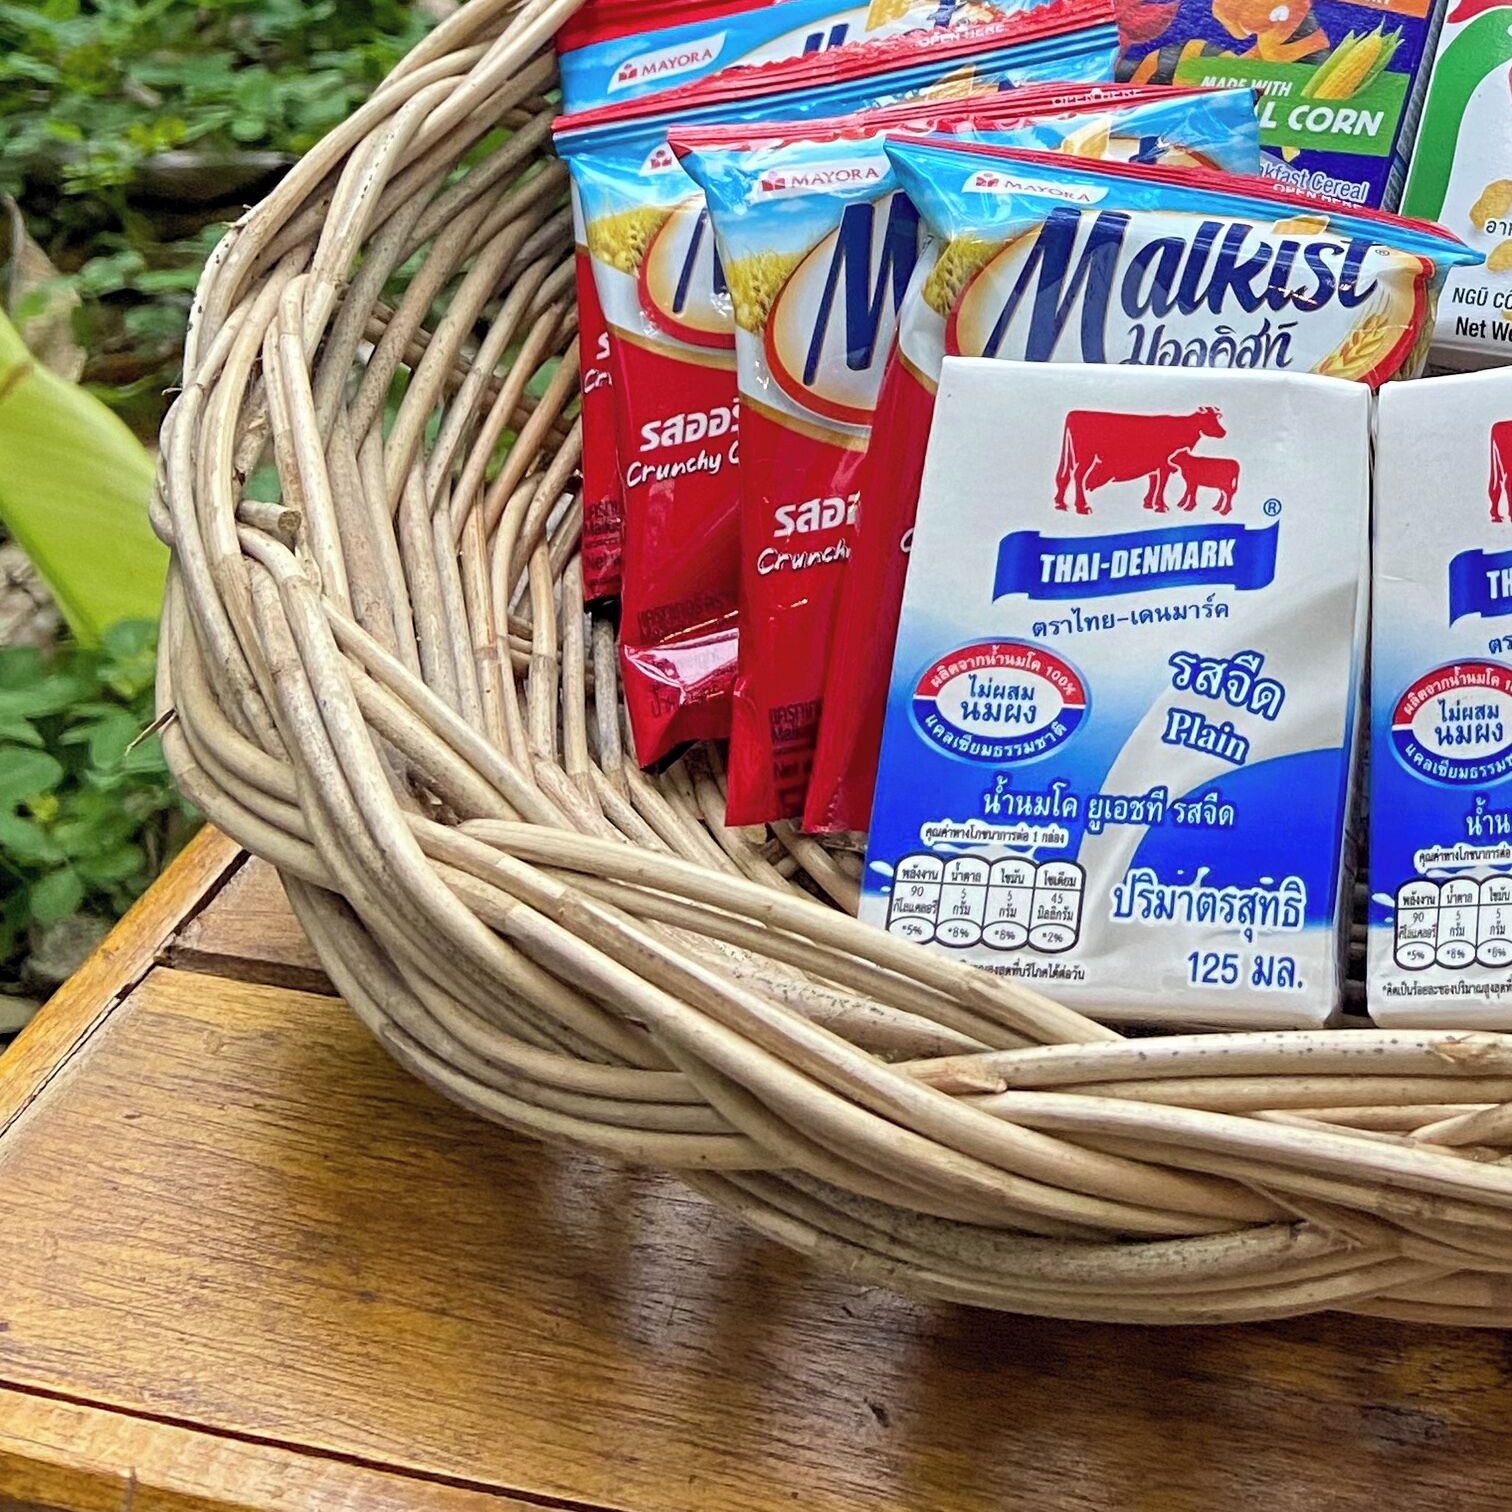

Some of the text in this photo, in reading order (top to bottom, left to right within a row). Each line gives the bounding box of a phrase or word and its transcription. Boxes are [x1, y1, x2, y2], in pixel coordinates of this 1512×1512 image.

[641, 47, 713, 78] MAYORA
[1252, 79, 1293, 97] WITH
[1287, 103, 1385, 137] CORN
[790, 165, 881, 190] MAYORA
[1004, 179, 1092, 203] MAYORA
[1260, 162, 1367, 201] kfast Cereal
[982, 206, 1381, 364] Malkist
[1452, 286, 1488, 308] NGŨ
[1455, 316, 1487, 339] Net
[626, 448, 722, 488] Crunchy
[757, 537, 852, 576] Crunch
[1040, 538, 1237, 584] THAI-DENMARK
[1032, 592, 1230, 638] ตราไทย-เดนมาร์ค
[968, 673, 1035, 702] ไม่ผสม
[1044, 665, 1077, 696] 100%
[1171, 651, 1284, 719] รสจืด
[960, 700, 1037, 724] นมผง
[1437, 698, 1500, 723] ไม่ผสม
[1166, 710, 1248, 763] Plain
[1434, 722, 1504, 747] นมผง
[982, 775, 1235, 830] น้ำนมโค ยูเอชที รสจืด
[911, 885, 925, 897] 90
[1050, 893, 1064, 904] 45
[1111, 869, 1307, 941] ปริมาตรสุทธิ
[1412, 912, 1425, 923] 90
[1188, 951, 1304, 988] 125 มล.
